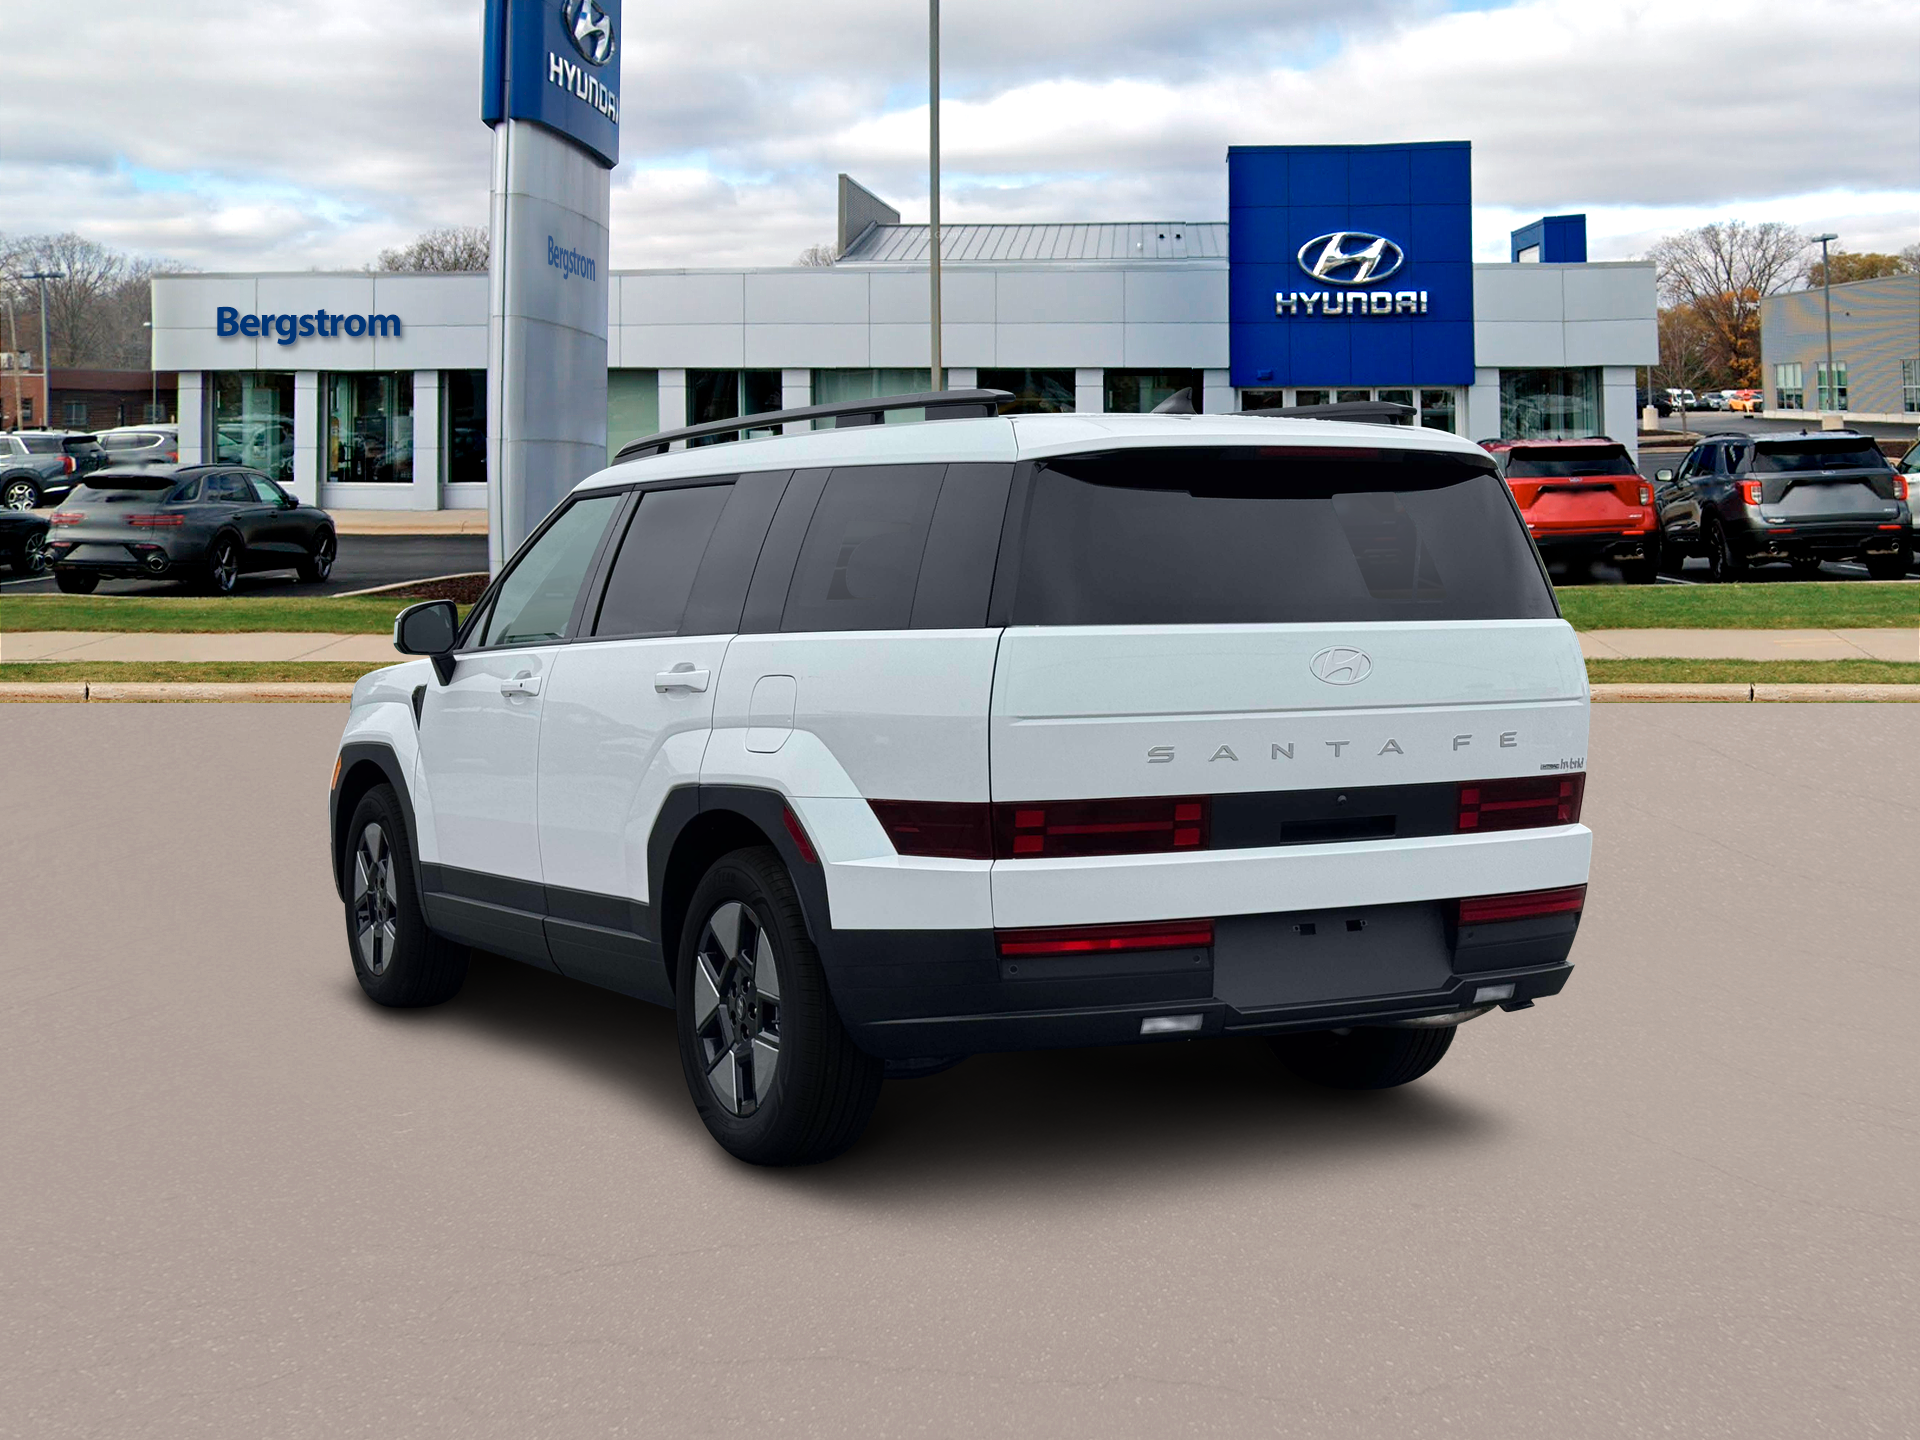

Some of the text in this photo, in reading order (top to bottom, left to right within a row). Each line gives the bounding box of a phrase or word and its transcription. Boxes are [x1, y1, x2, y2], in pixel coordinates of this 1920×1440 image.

[547, 51, 619, 124] HYUNDAI
[548, 235, 596, 281] Bergstrom
[1276, 291, 1428, 315] HYUNDAI
[216, 306, 402, 345] Bergstrom
[1147, 730, 1518, 764] SANTA FE
